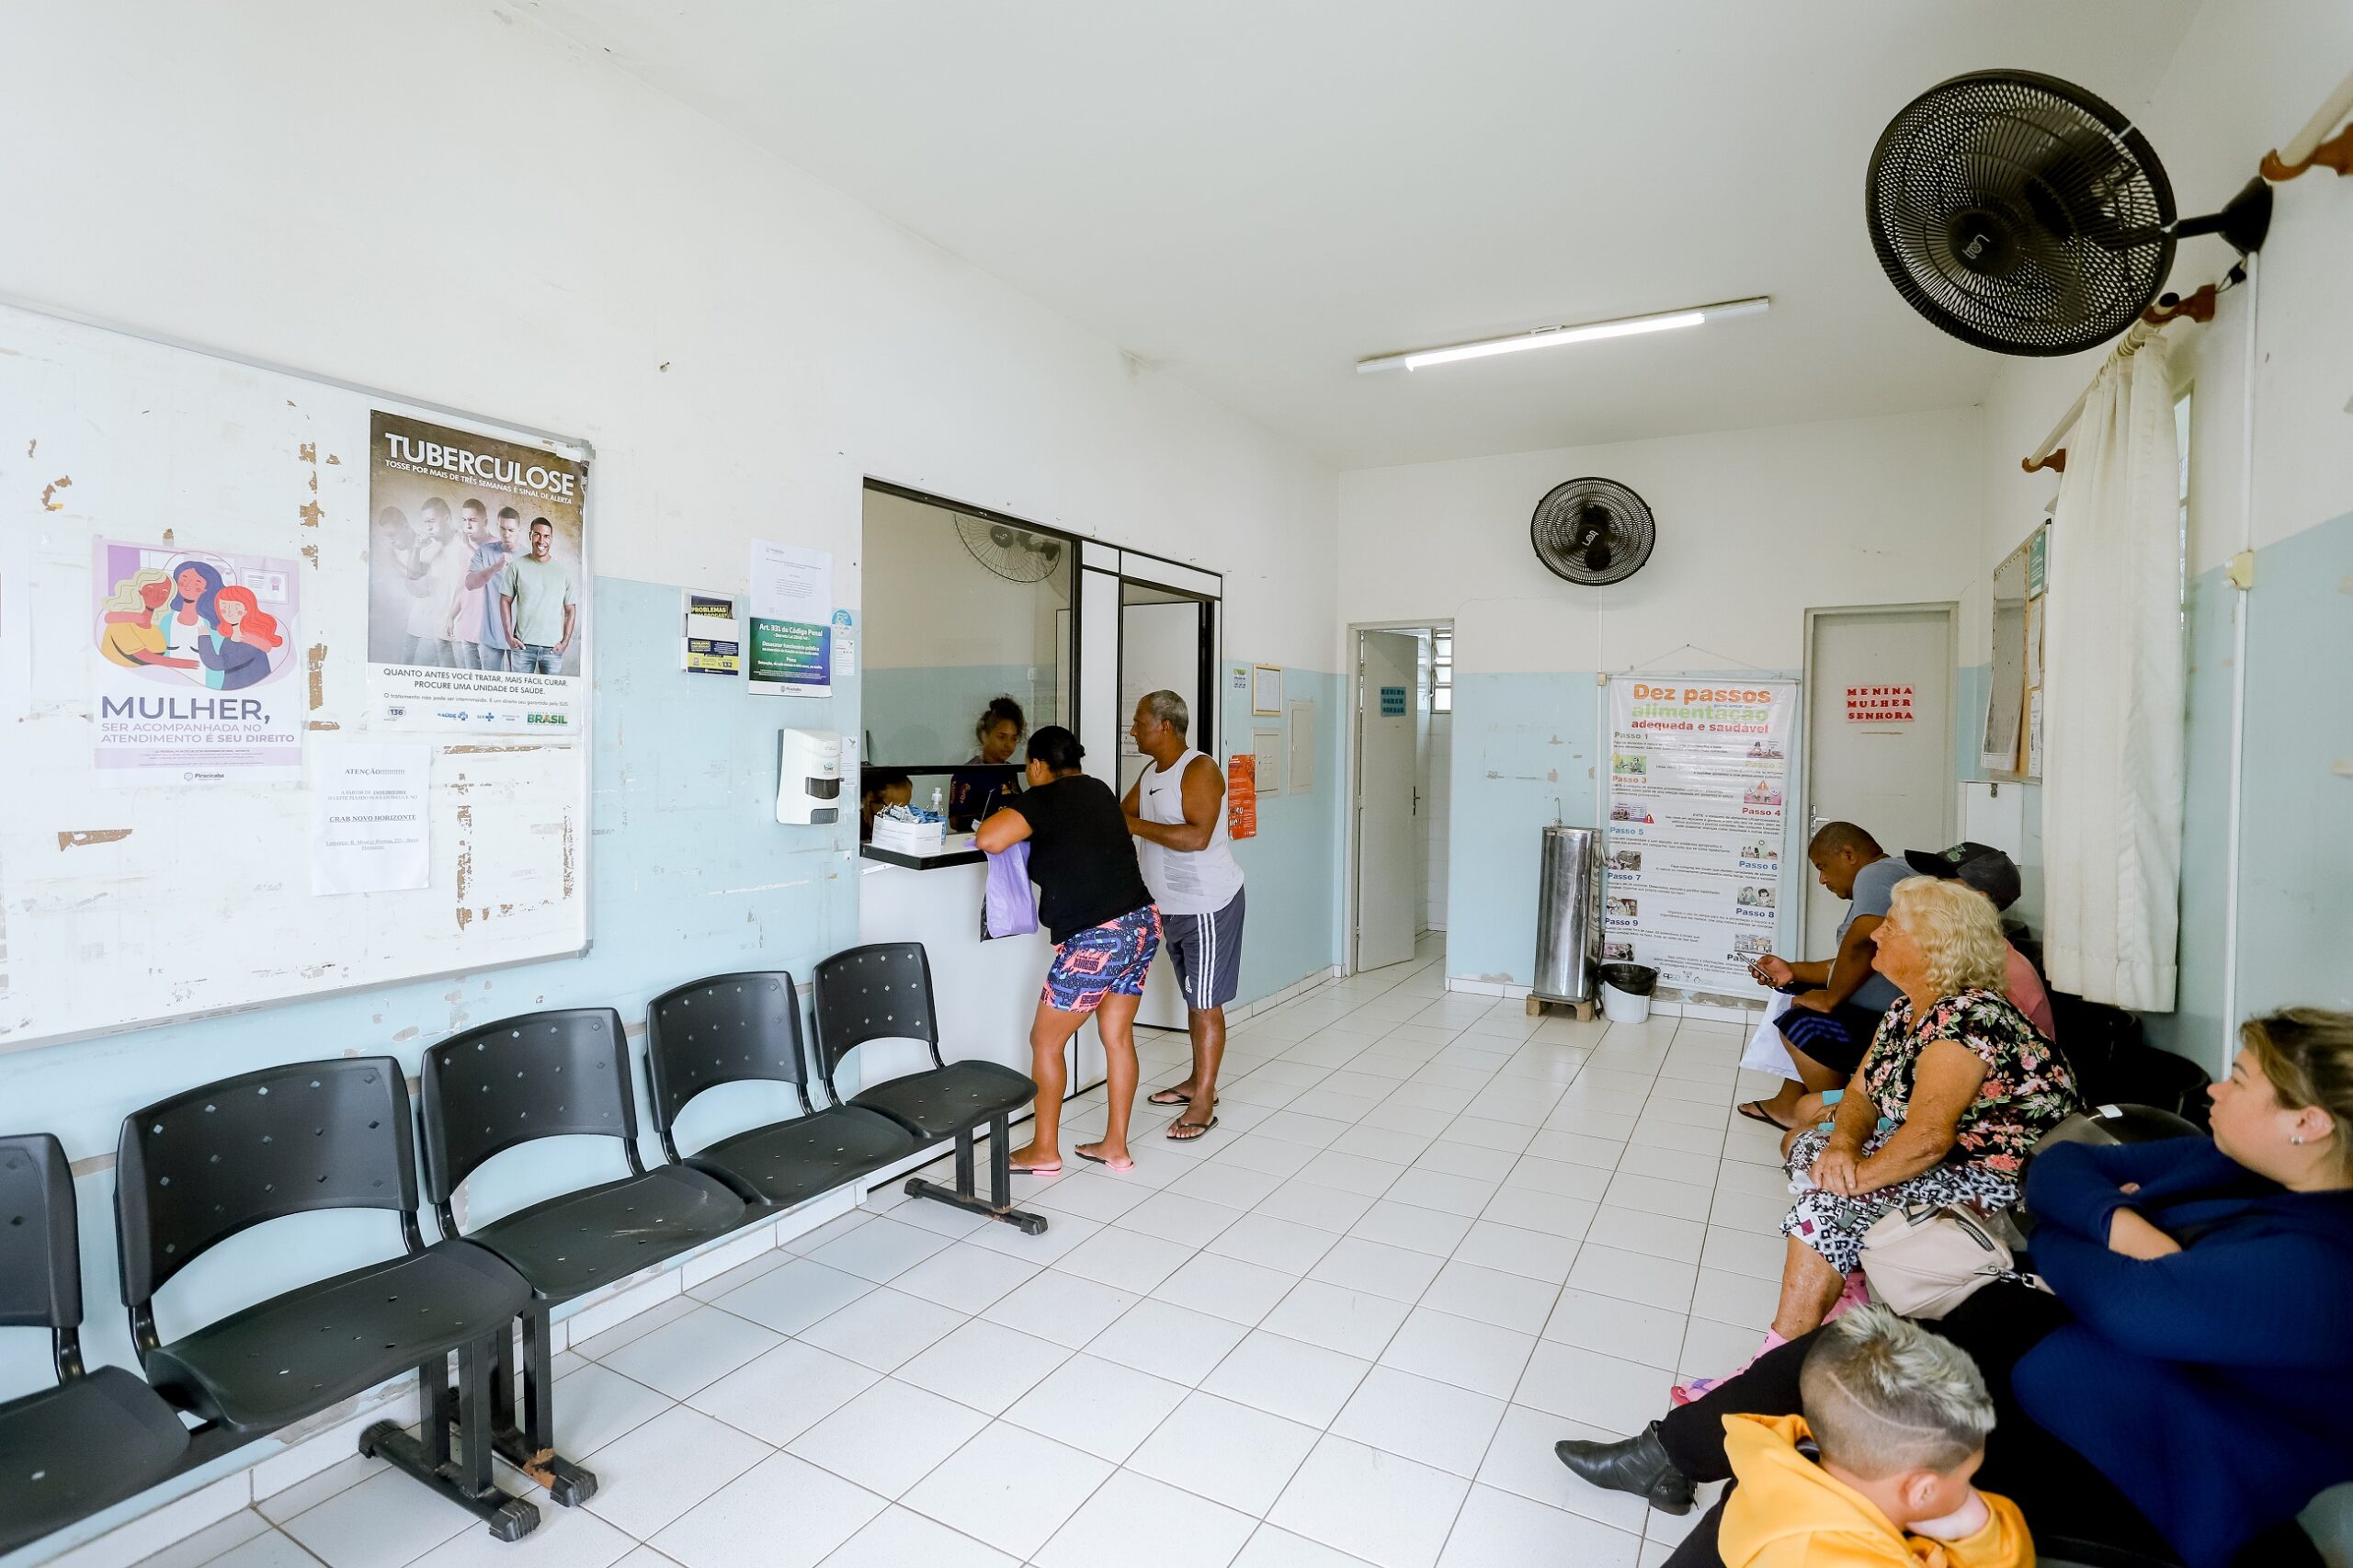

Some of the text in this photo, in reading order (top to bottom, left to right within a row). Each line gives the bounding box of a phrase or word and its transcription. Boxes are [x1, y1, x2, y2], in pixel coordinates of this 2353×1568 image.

[385, 432, 574, 496] TUBERCULOSE
[385, 460, 410, 472] TOSSE
[412, 465, 428, 475] POR
[430, 469, 448, 479] MAIS
[449, 473, 460, 482] DE
[460, 474, 477, 485] TRÊS
[478, 479, 512, 493] SEMANAS
[513, 484, 518, 494] É
[519, 488, 539, 498] SINAL
[550, 494, 572, 505] ALERTA
[789, 627, 807, 635] Código
[383, 668, 422, 677] QUANTO
[452, 671, 473, 680] VOCÊ
[475, 674, 503, 683] TRATAR,
[524, 676, 542, 685] FÁCIL
[414, 680, 451, 689] PROCURE
[473, 684, 508, 692] UNIDADE
[521, 686, 545, 695] SAÚDE.
[1847, 687, 1912, 696] MENINA
[1633, 683, 1771, 705] Dez passos
[1847, 699, 1911, 708] MULHER
[102, 696, 270, 725] MULHER,
[527, 714, 568, 724] BRASIL
[101, 722, 262, 732] SER ACOMPANHADA NO
[1631, 720, 1693, 731] adequada
[1709, 723, 1768, 733] saudável
[101, 733, 295, 743] ATENDIMENTO É SEU DIREITO
[1614, 731, 1641, 740] Passo
[1612, 776, 1640, 784] Passo
[1742, 807, 1772, 816] Passo
[1610, 827, 1636, 835] Passo
[1739, 860, 1768, 869] Passo
[1608, 873, 1633, 881] Passo
[1736, 908, 1765, 917] Passo
[1605, 918, 1630, 926] Passo
